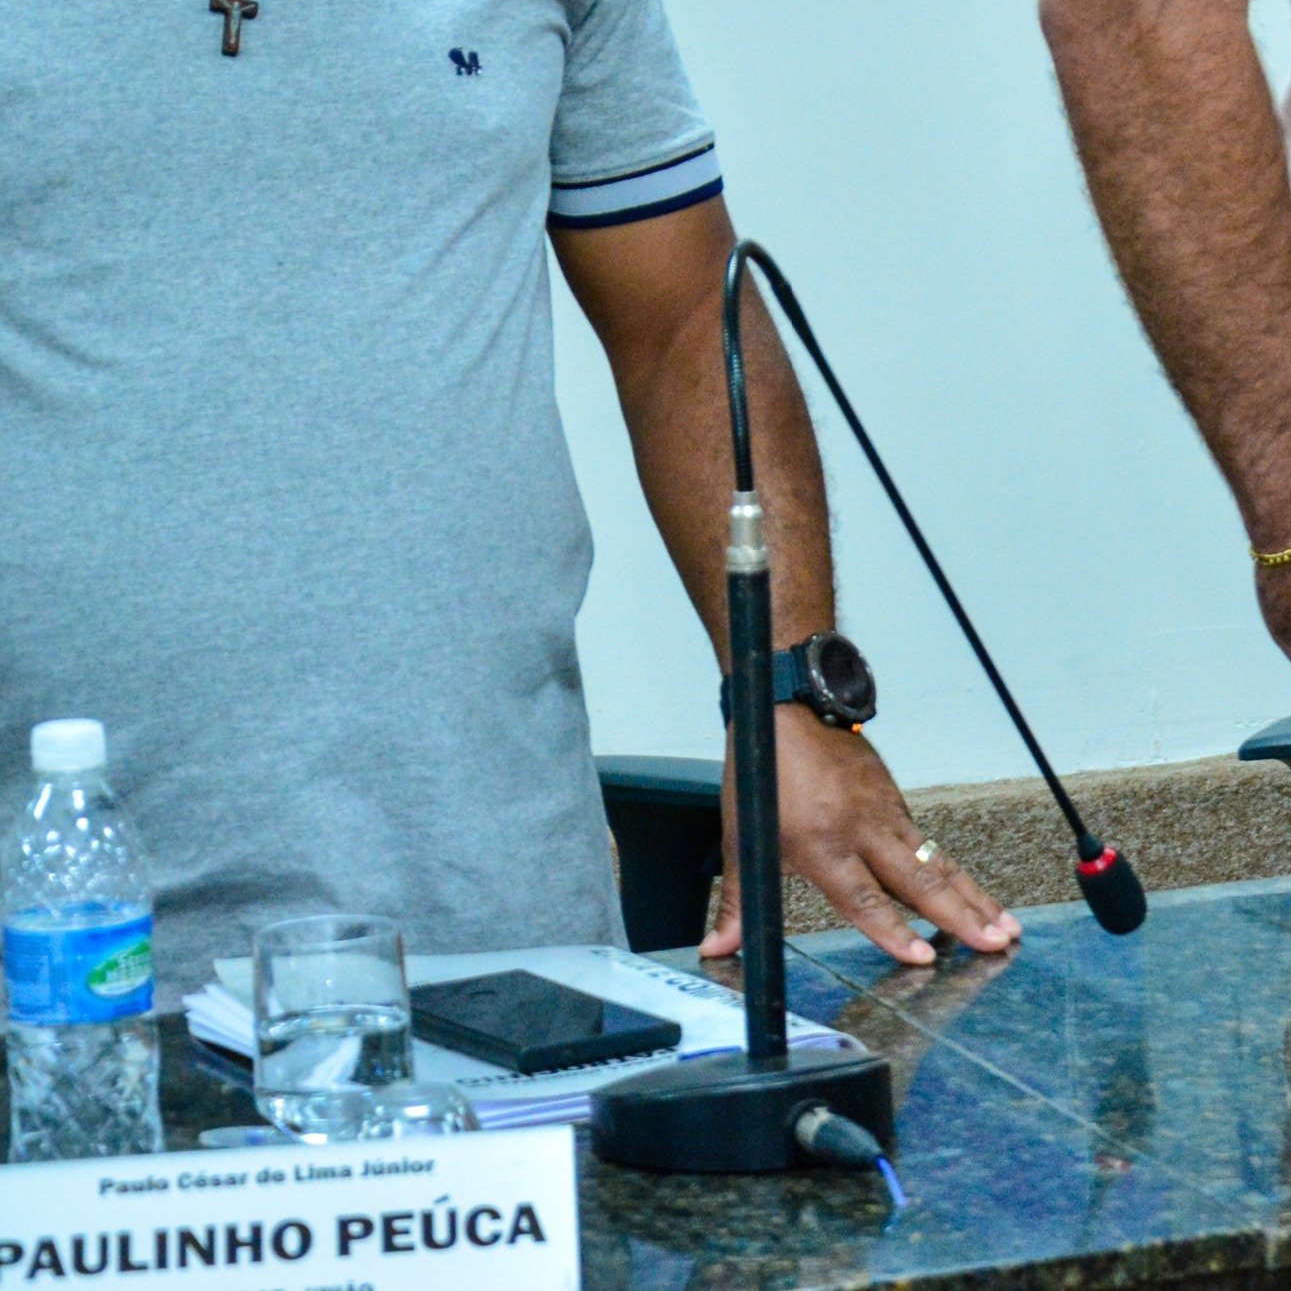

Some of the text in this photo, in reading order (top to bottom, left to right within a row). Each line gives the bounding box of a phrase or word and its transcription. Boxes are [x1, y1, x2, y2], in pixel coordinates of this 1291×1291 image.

[98, 1159, 435, 1195] Paulo César de Lima Júnior
[0, 1194, 547, 1284] PAULINHO PEÚCA
